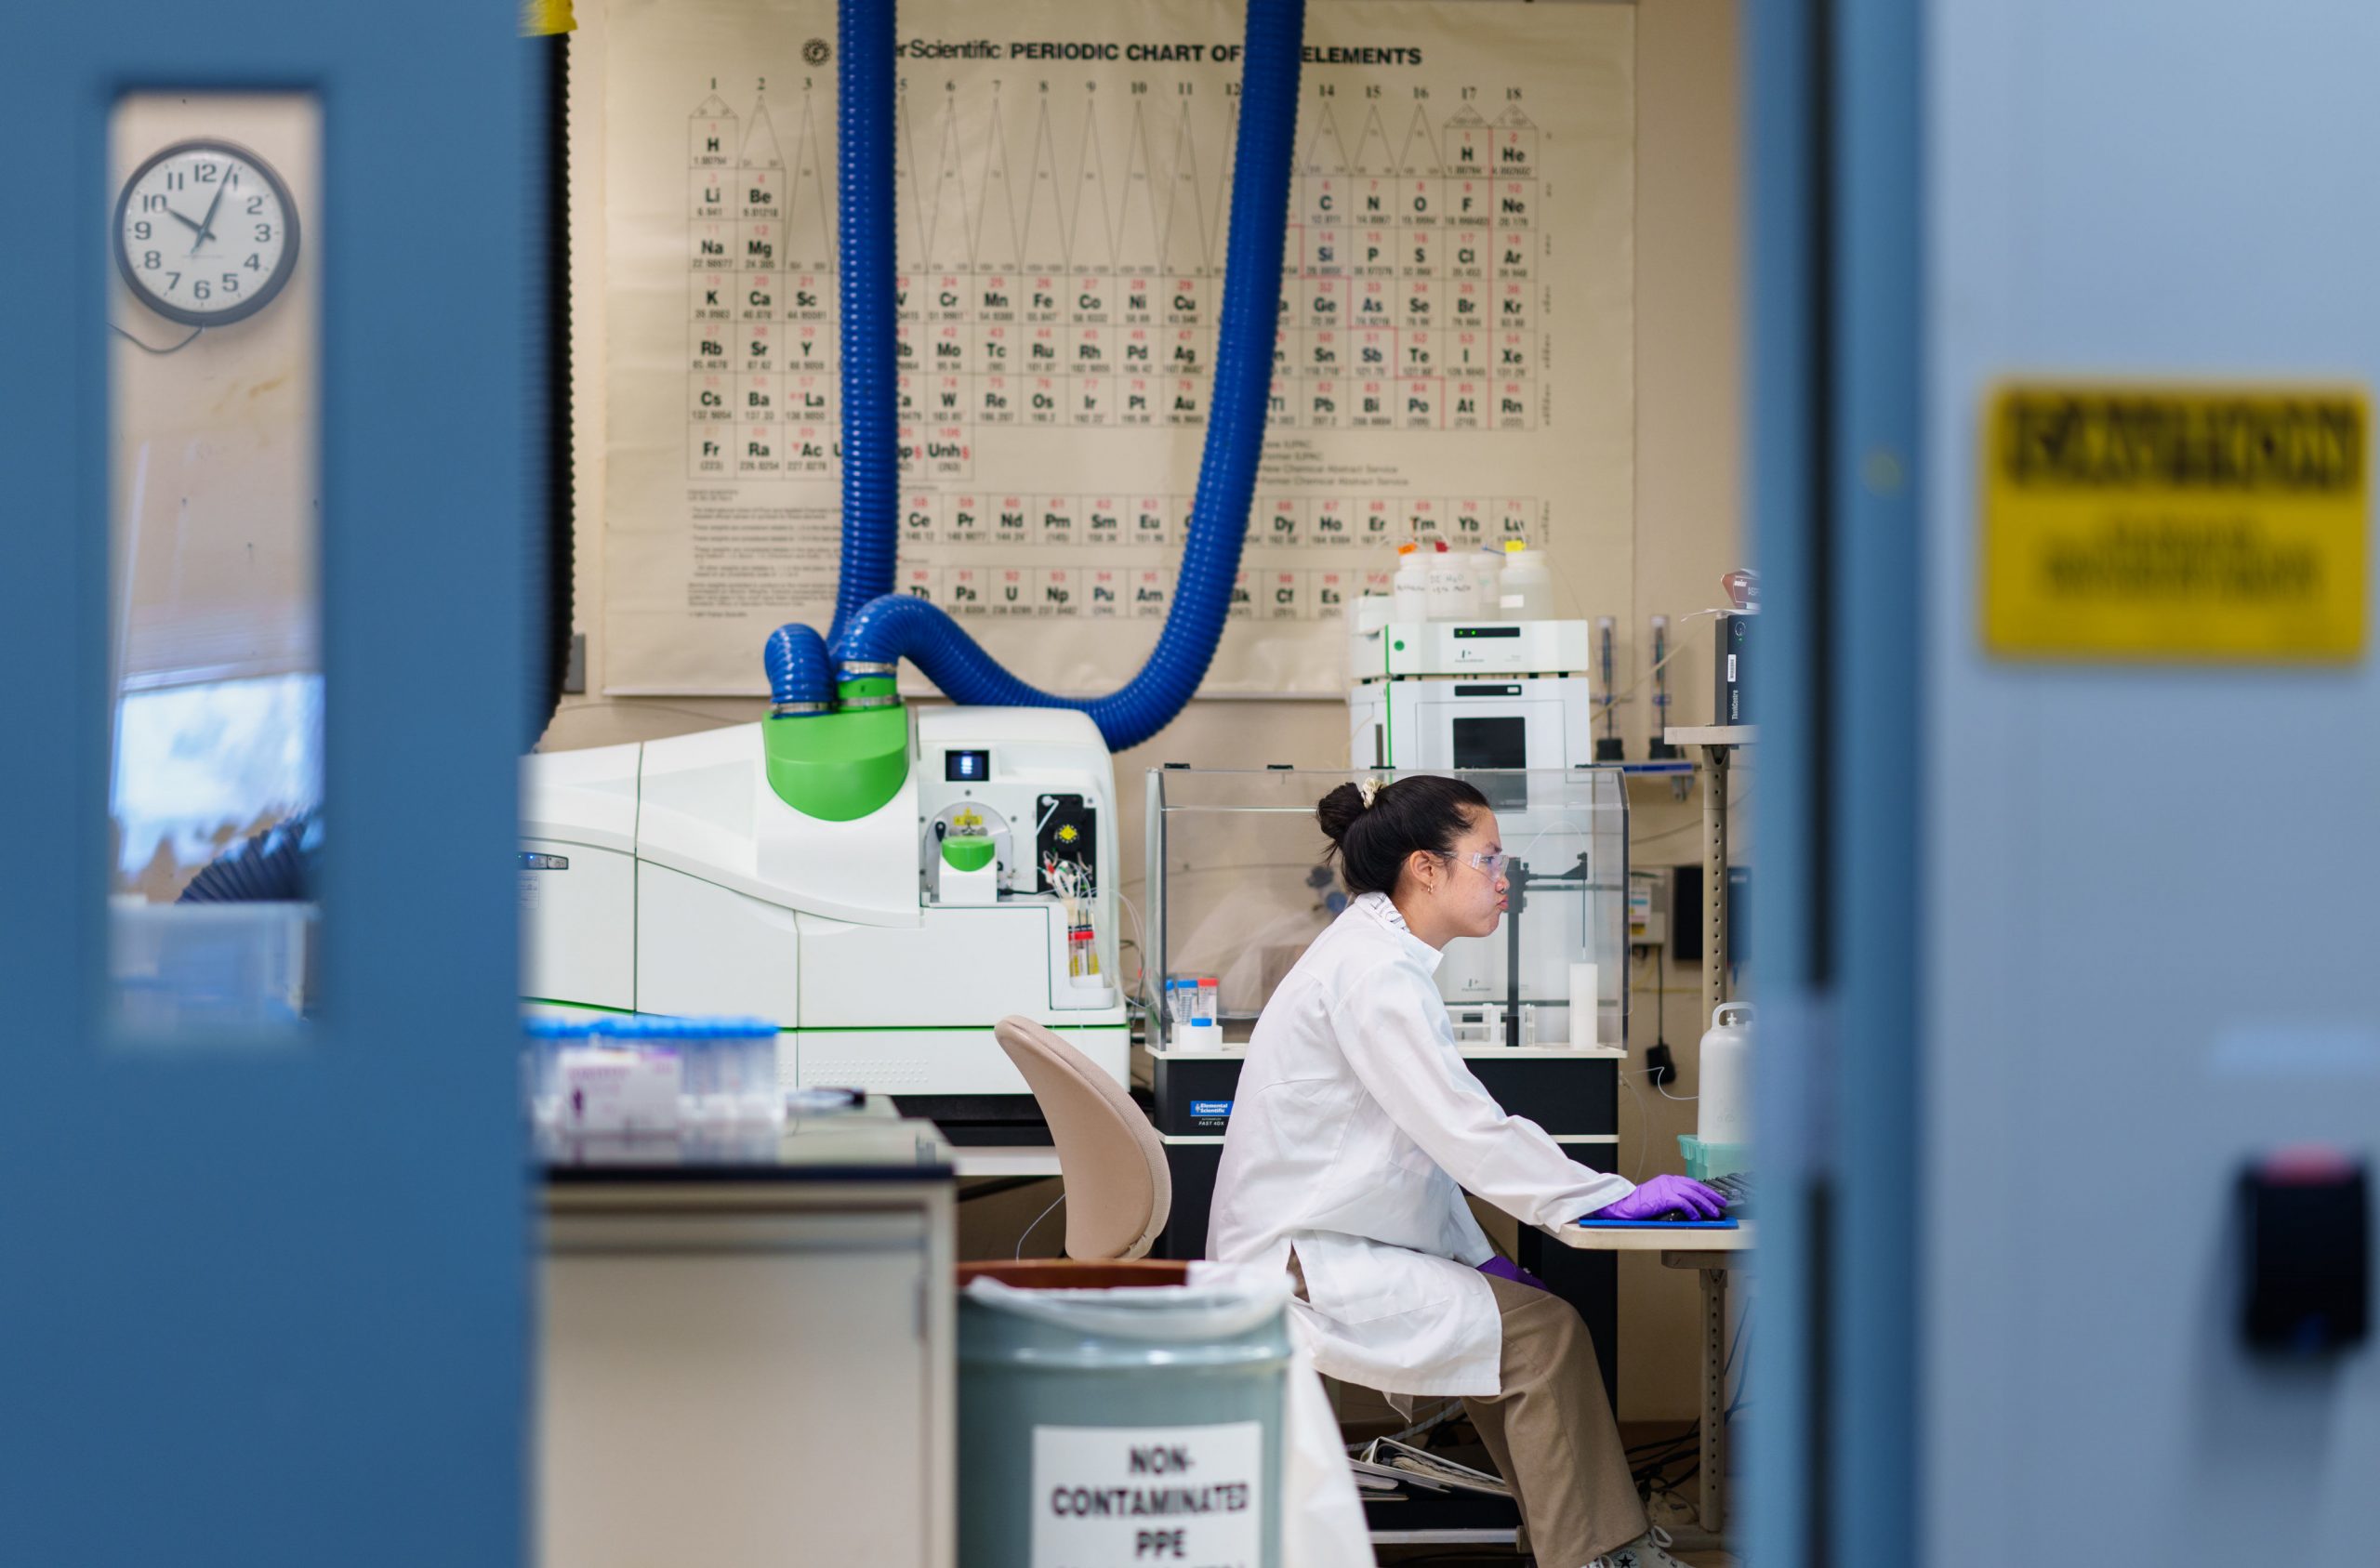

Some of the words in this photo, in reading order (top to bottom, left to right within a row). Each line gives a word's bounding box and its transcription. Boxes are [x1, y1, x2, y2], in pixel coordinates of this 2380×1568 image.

[909, 39, 1000, 59] Scientific
[1011, 43, 1118, 60] PERIODIC
[1126, 45, 1205, 61] CHART
[1210, 45, 1240, 62] OF
[1302, 46, 1421, 65] ELEMENTS
[710, 77, 717, 90] 1
[757, 76, 766, 91] 2
[804, 76, 813, 90] 3
[992, 79, 1002, 91] 7
[1130, 81, 1148, 95] 10
[1178, 81, 1193, 96] 11
[1318, 84, 1335, 98] 14
[1366, 85, 1382, 99] 15
[1413, 86, 1430, 99] 16
[1461, 86, 1477, 100] 17
[1506, 87, 1522, 100] 18
[707, 138, 720, 152] H
[1461, 147, 1474, 162] H
[1501, 147, 1526, 163] He
[167, 173, 183, 190] 11
[195, 165, 216, 182] 12
[144, 195, 165, 212] 10
[247, 197, 262, 215] 2
[705, 187, 721, 204] Li
[748, 188, 772, 204] Be
[1318, 194, 1332, 211] C
[1367, 196, 1381, 211] N
[1413, 196, 1427, 213] O
[1461, 196, 1473, 213] F
[1501, 198, 1526, 214] Ne
[135, 222, 151, 240] 9
[255, 224, 271, 242] 3
[145, 251, 161, 269] 8
[244, 254, 259, 270] 4
[701, 240, 724, 256] Na
[747, 240, 773, 260] Mg
[1317, 245, 1334, 263] Si
[1367, 246, 1380, 262] P
[1414, 247, 1426, 264] S
[1457, 247, 1475, 265] Cl
[1503, 249, 1522, 265] Ar
[166, 272, 180, 290] 7
[194, 282, 210, 299] 6
[223, 273, 238, 291] 5
[706, 290, 719, 306] K
[748, 290, 772, 307] Ca
[796, 290, 816, 308] Sc
[939, 291, 959, 308] Cr
[984, 292, 1009, 308] Mn
[1033, 292, 1053, 309] Fe
[1078, 293, 1102, 310] Co
[1129, 295, 1146, 310] Ni
[1173, 295, 1197, 311] Cu
[1313, 296, 1337, 313] Ge
[1362, 296, 1383, 313] As
[1409, 296, 1430, 313] Se
[1457, 297, 1475, 314] Br
[1503, 299, 1522, 314] Kr
[700, 340, 723, 356] Rb
[750, 340, 768, 357] Sr
[800, 341, 813, 357] Y
[936, 341, 961, 358] Mo
[985, 341, 1006, 358] Tc
[1032, 342, 1054, 359] Ru
[1078, 344, 1102, 360] Rh
[1126, 344, 1148, 361] Pd
[1174, 345, 1196, 365] Ag
[1314, 346, 1336, 363] Sn
[1361, 347, 1383, 363] Sb
[1408, 347, 1430, 363] Te
[1502, 349, 1523, 364] Xe
[700, 390, 722, 407] Cs
[747, 391, 771, 407] Ba
[941, 392, 957, 407] W
[985, 392, 1008, 409] Re
[1031, 392, 1054, 410] Os
[1083, 394, 1097, 410] Ir
[1129, 394, 1146, 410] Pt
[1174, 395, 1196, 411] Au
[1313, 396, 1335, 413] Pb
[1363, 397, 1380, 414] Bi
[1408, 397, 1430, 414] Po
[1457, 398, 1474, 414] At
[1501, 398, 1524, 414] Rn
[703, 441, 720, 456] Fr
[747, 441, 771, 457] Ra
[907, 511, 931, 529] Ce
[957, 512, 975, 527] Pr
[1000, 512, 1024, 529] Nd
[1044, 512, 1071, 528] Pm
[1091, 513, 1117, 530] Sm
[1139, 513, 1161, 530] Eu
[1274, 515, 1295, 536] Dy
[1319, 516, 1342, 532] Ho
[1368, 516, 1385, 532] Er
[1410, 516, 1436, 532] Tm
[1458, 517, 1480, 532] Yb
[955, 585, 977, 601] Pa
[1005, 586, 1019, 602] U
[1046, 586, 1069, 604] Np
[1092, 586, 1115, 602] Pu
[1136, 586, 1164, 602] Am
[1275, 587, 1295, 605] Cf
[1320, 588, 1341, 605] Es
[1130, 1446, 1195, 1474] NON-
[1051, 1484, 1248, 1518] CONTAMINATED
[1136, 1530, 1185, 1558] PPE
